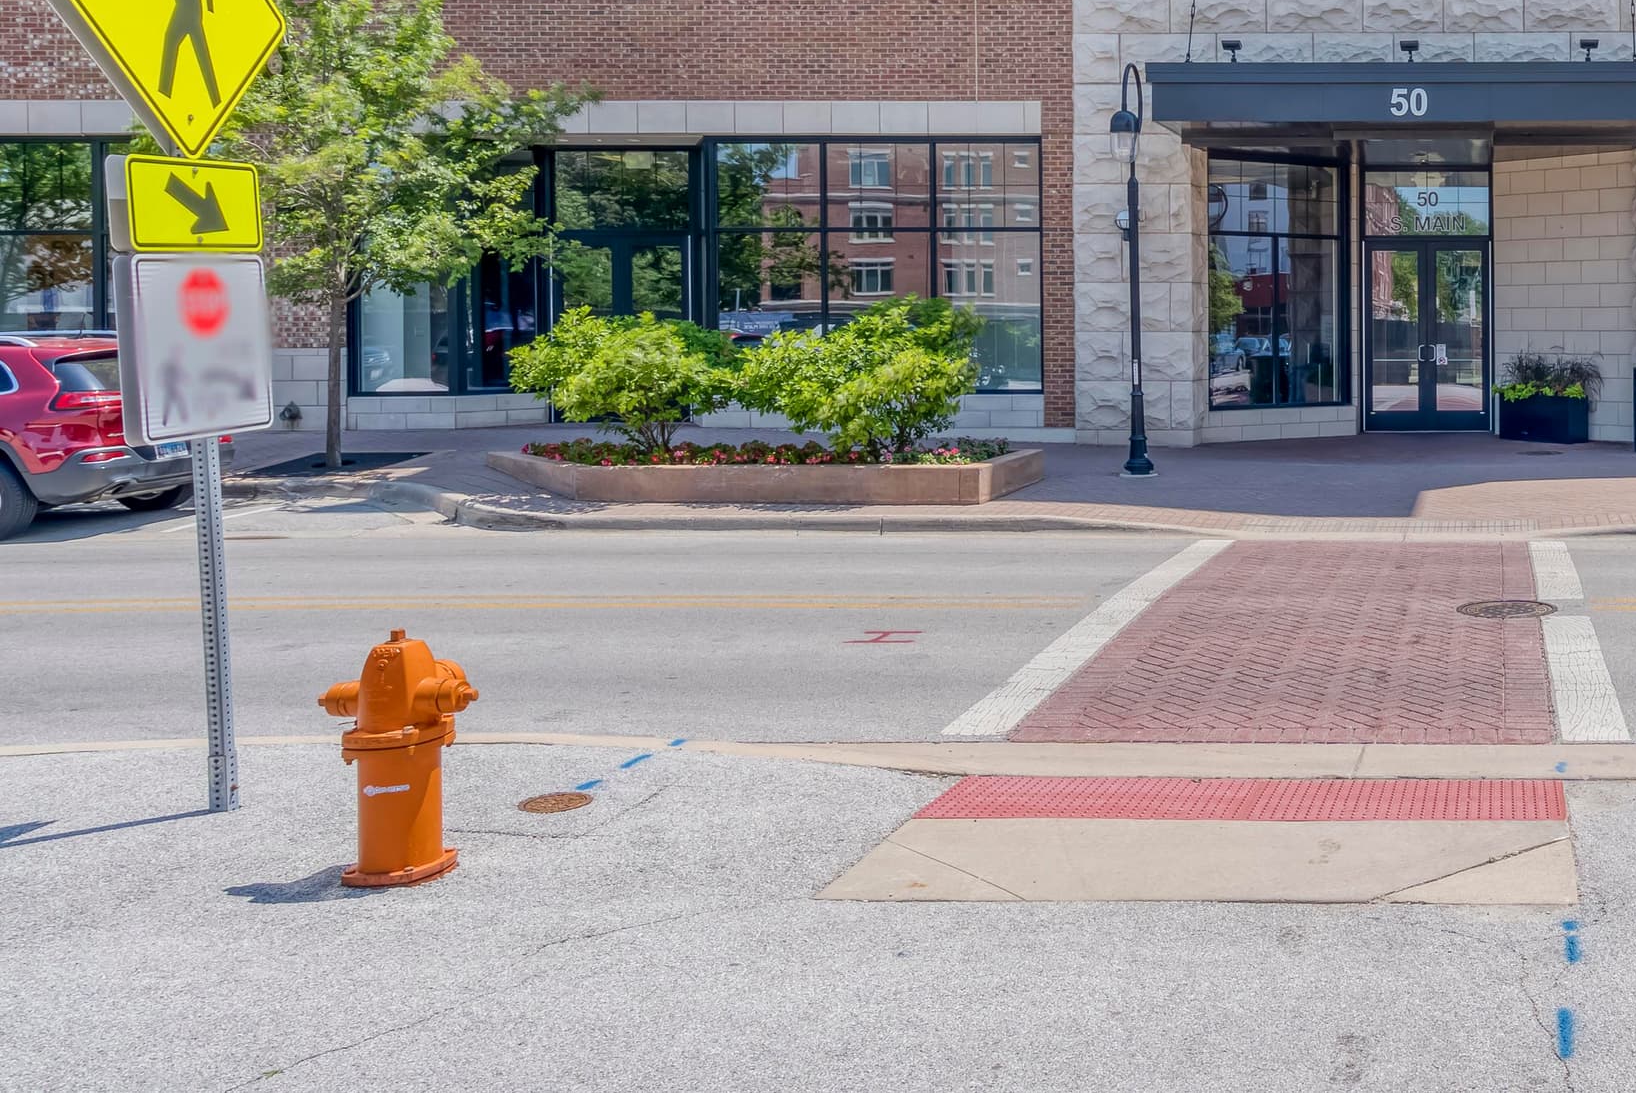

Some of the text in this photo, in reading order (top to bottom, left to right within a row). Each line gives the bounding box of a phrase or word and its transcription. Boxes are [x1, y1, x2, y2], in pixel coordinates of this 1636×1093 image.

[1390, 88, 1428, 116] 50
[1417, 191, 1439, 207] 50
[1390, 215, 1466, 232] S. MAIN
